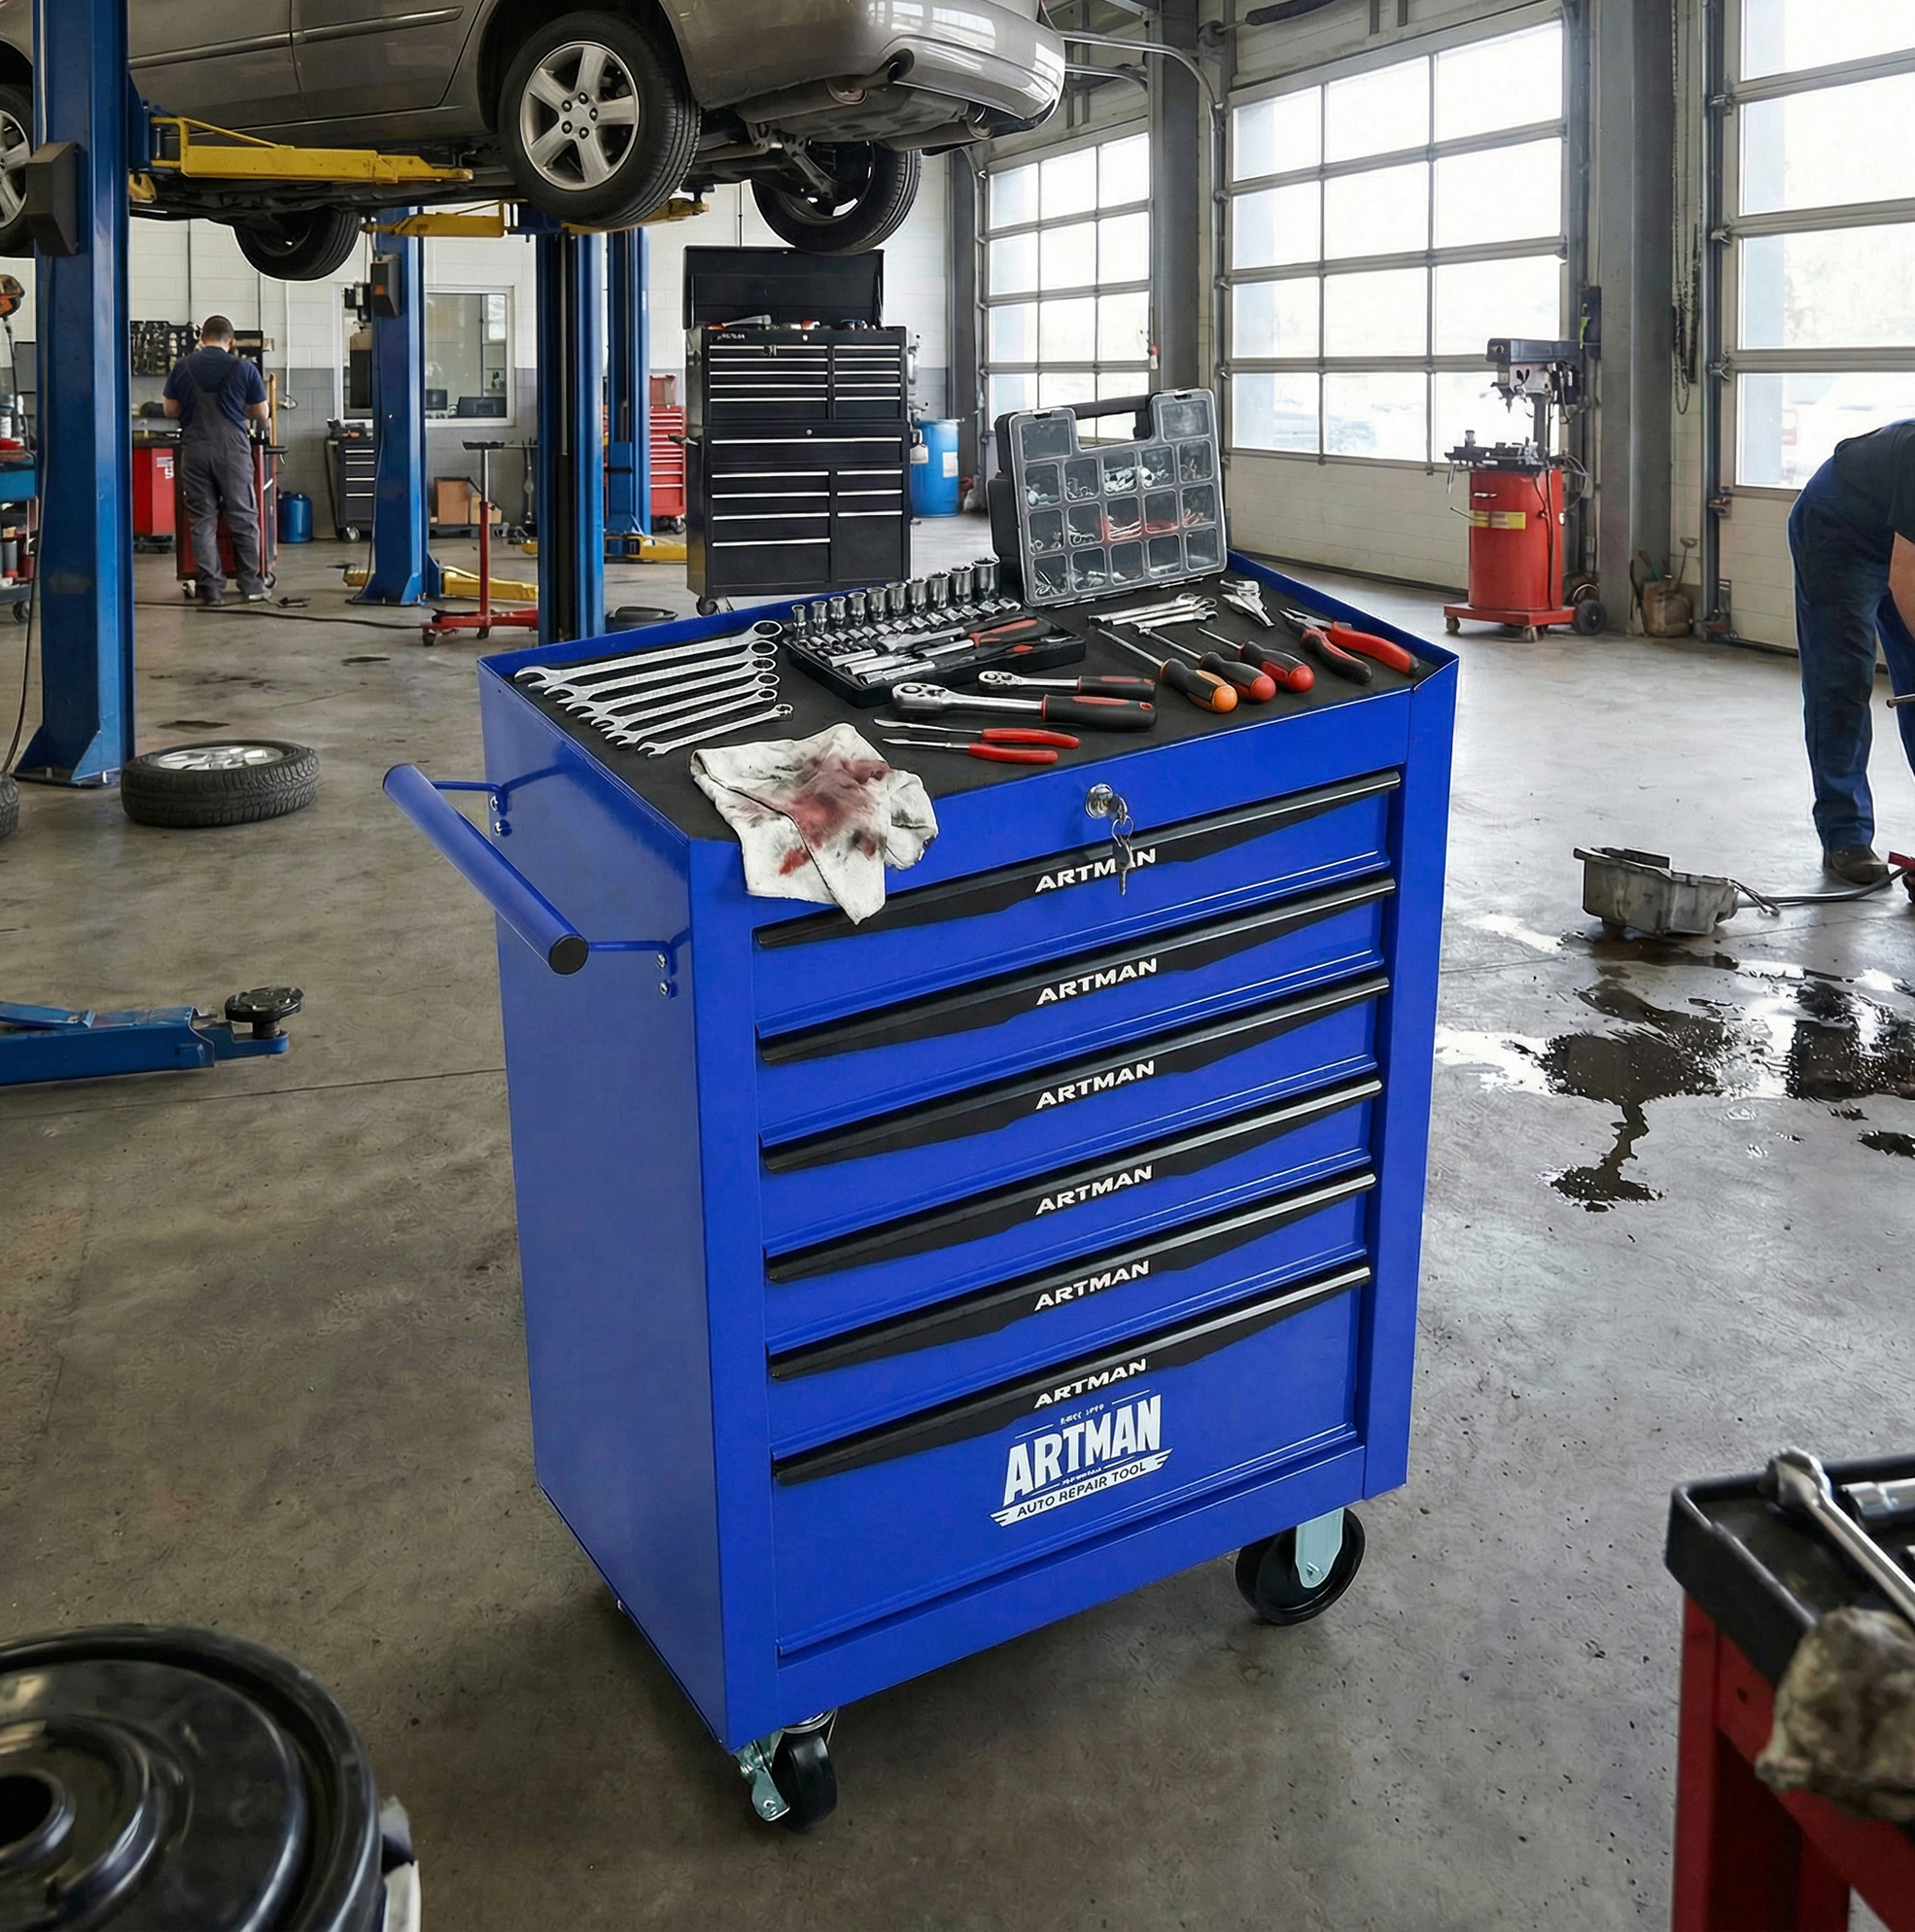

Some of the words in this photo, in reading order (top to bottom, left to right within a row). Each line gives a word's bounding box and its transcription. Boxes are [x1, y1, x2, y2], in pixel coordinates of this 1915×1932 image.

[1035, 847, 1156, 893] ARTMN
[1036, 957, 1157, 1006] ARTMAN
[1035, 1059, 1155, 1110] ARTMAN
[1035, 1164, 1152, 1216] ARTMAN
[1034, 1259, 1149, 1311] ARTMAN
[1033, 1358, 1147, 1409] ARTMAN
[1002, 1394, 1162, 1507] ARTMAN
[1017, 1496, 1056, 1517] AUTO
[1059, 1475, 1108, 1502] REPAIR
[1111, 1462, 1147, 1482] TOOL
